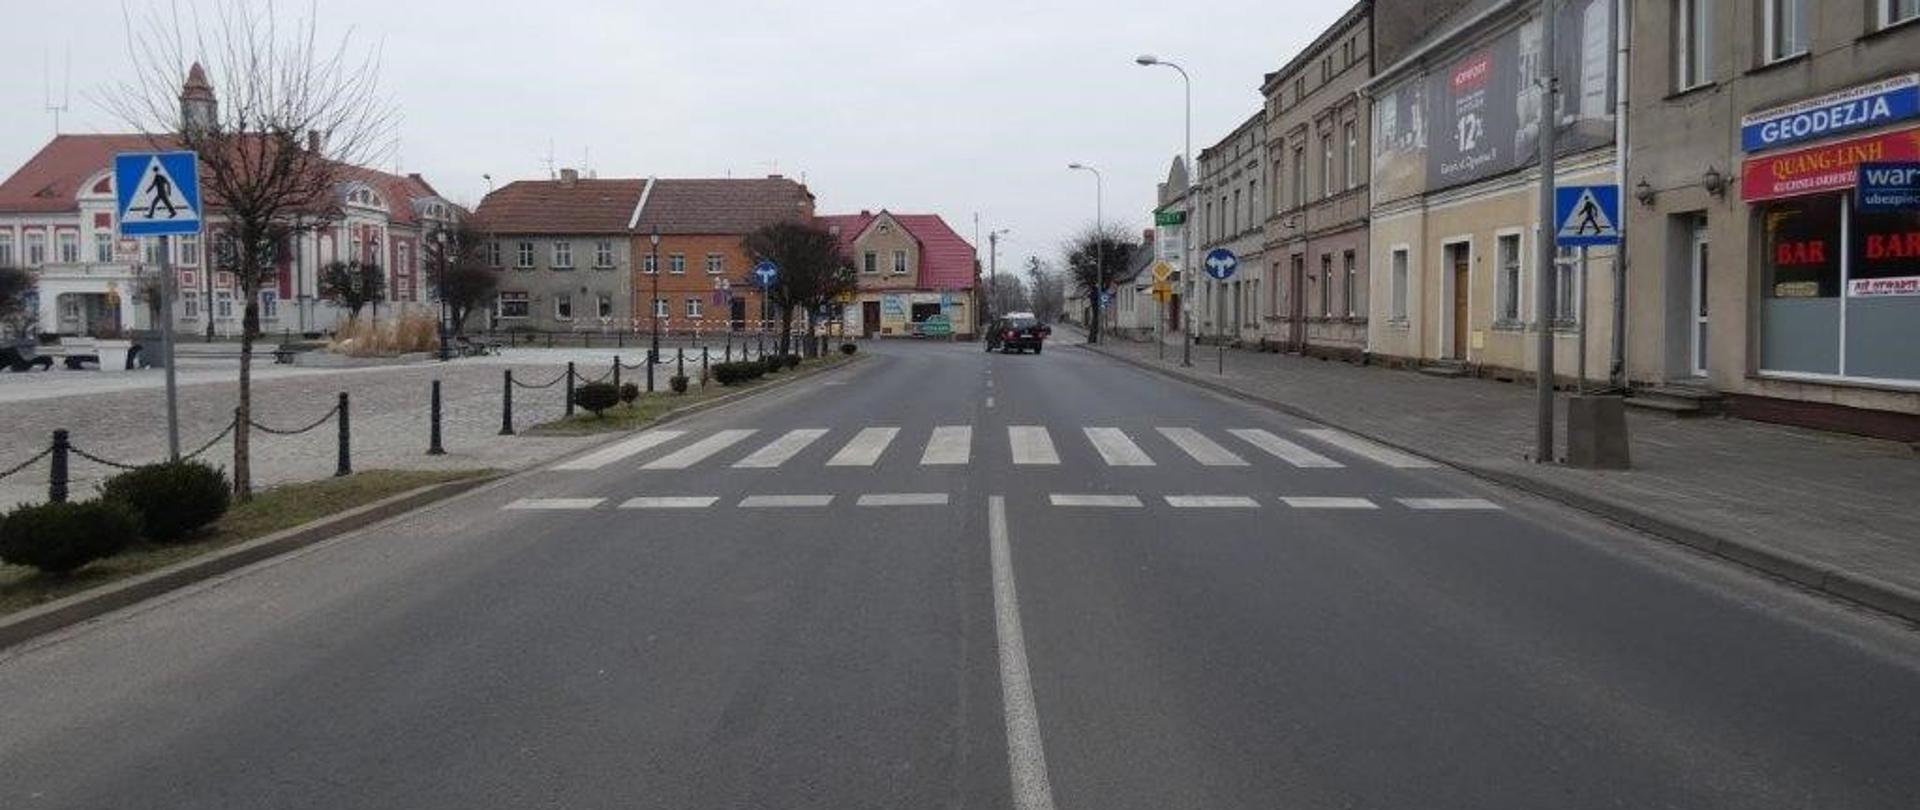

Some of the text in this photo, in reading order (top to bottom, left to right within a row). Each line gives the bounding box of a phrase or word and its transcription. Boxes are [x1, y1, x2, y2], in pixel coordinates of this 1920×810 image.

[1761, 97, 1890, 142] GEODEZJA
[1772, 141, 1882, 179] QUANG-LINH
[1777, 241, 1824, 264] BAR
[1867, 233, 1920, 258] BAR
